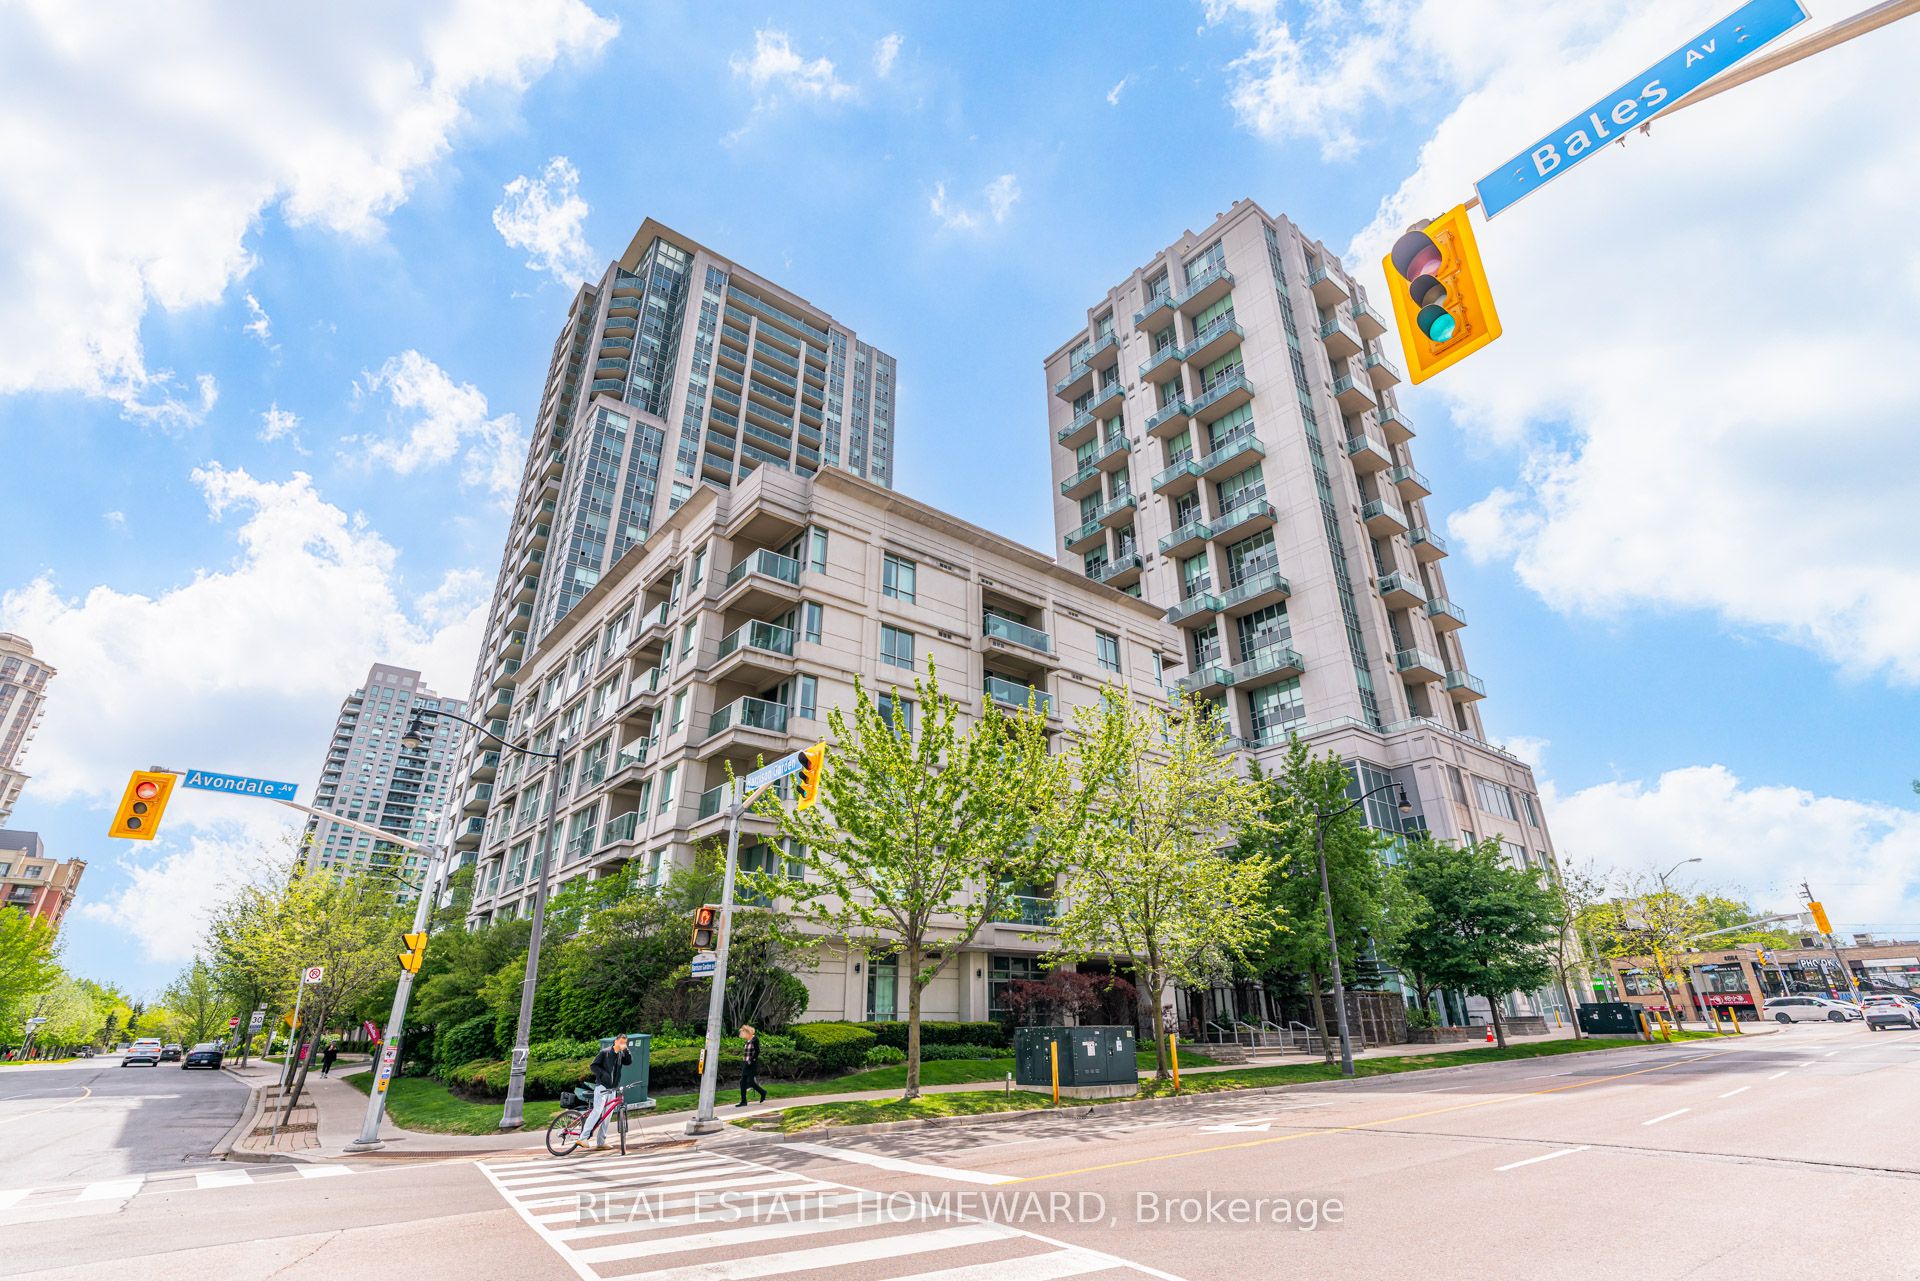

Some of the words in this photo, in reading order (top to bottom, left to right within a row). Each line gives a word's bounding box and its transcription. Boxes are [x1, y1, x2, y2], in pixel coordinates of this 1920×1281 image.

[1531, 79, 1668, 178] Bales
[1683, 37, 1717, 69] Av
[188, 771, 274, 795] Avondale
[281, 784, 293, 792] Av
[251, 1016, 263, 1024] 30
